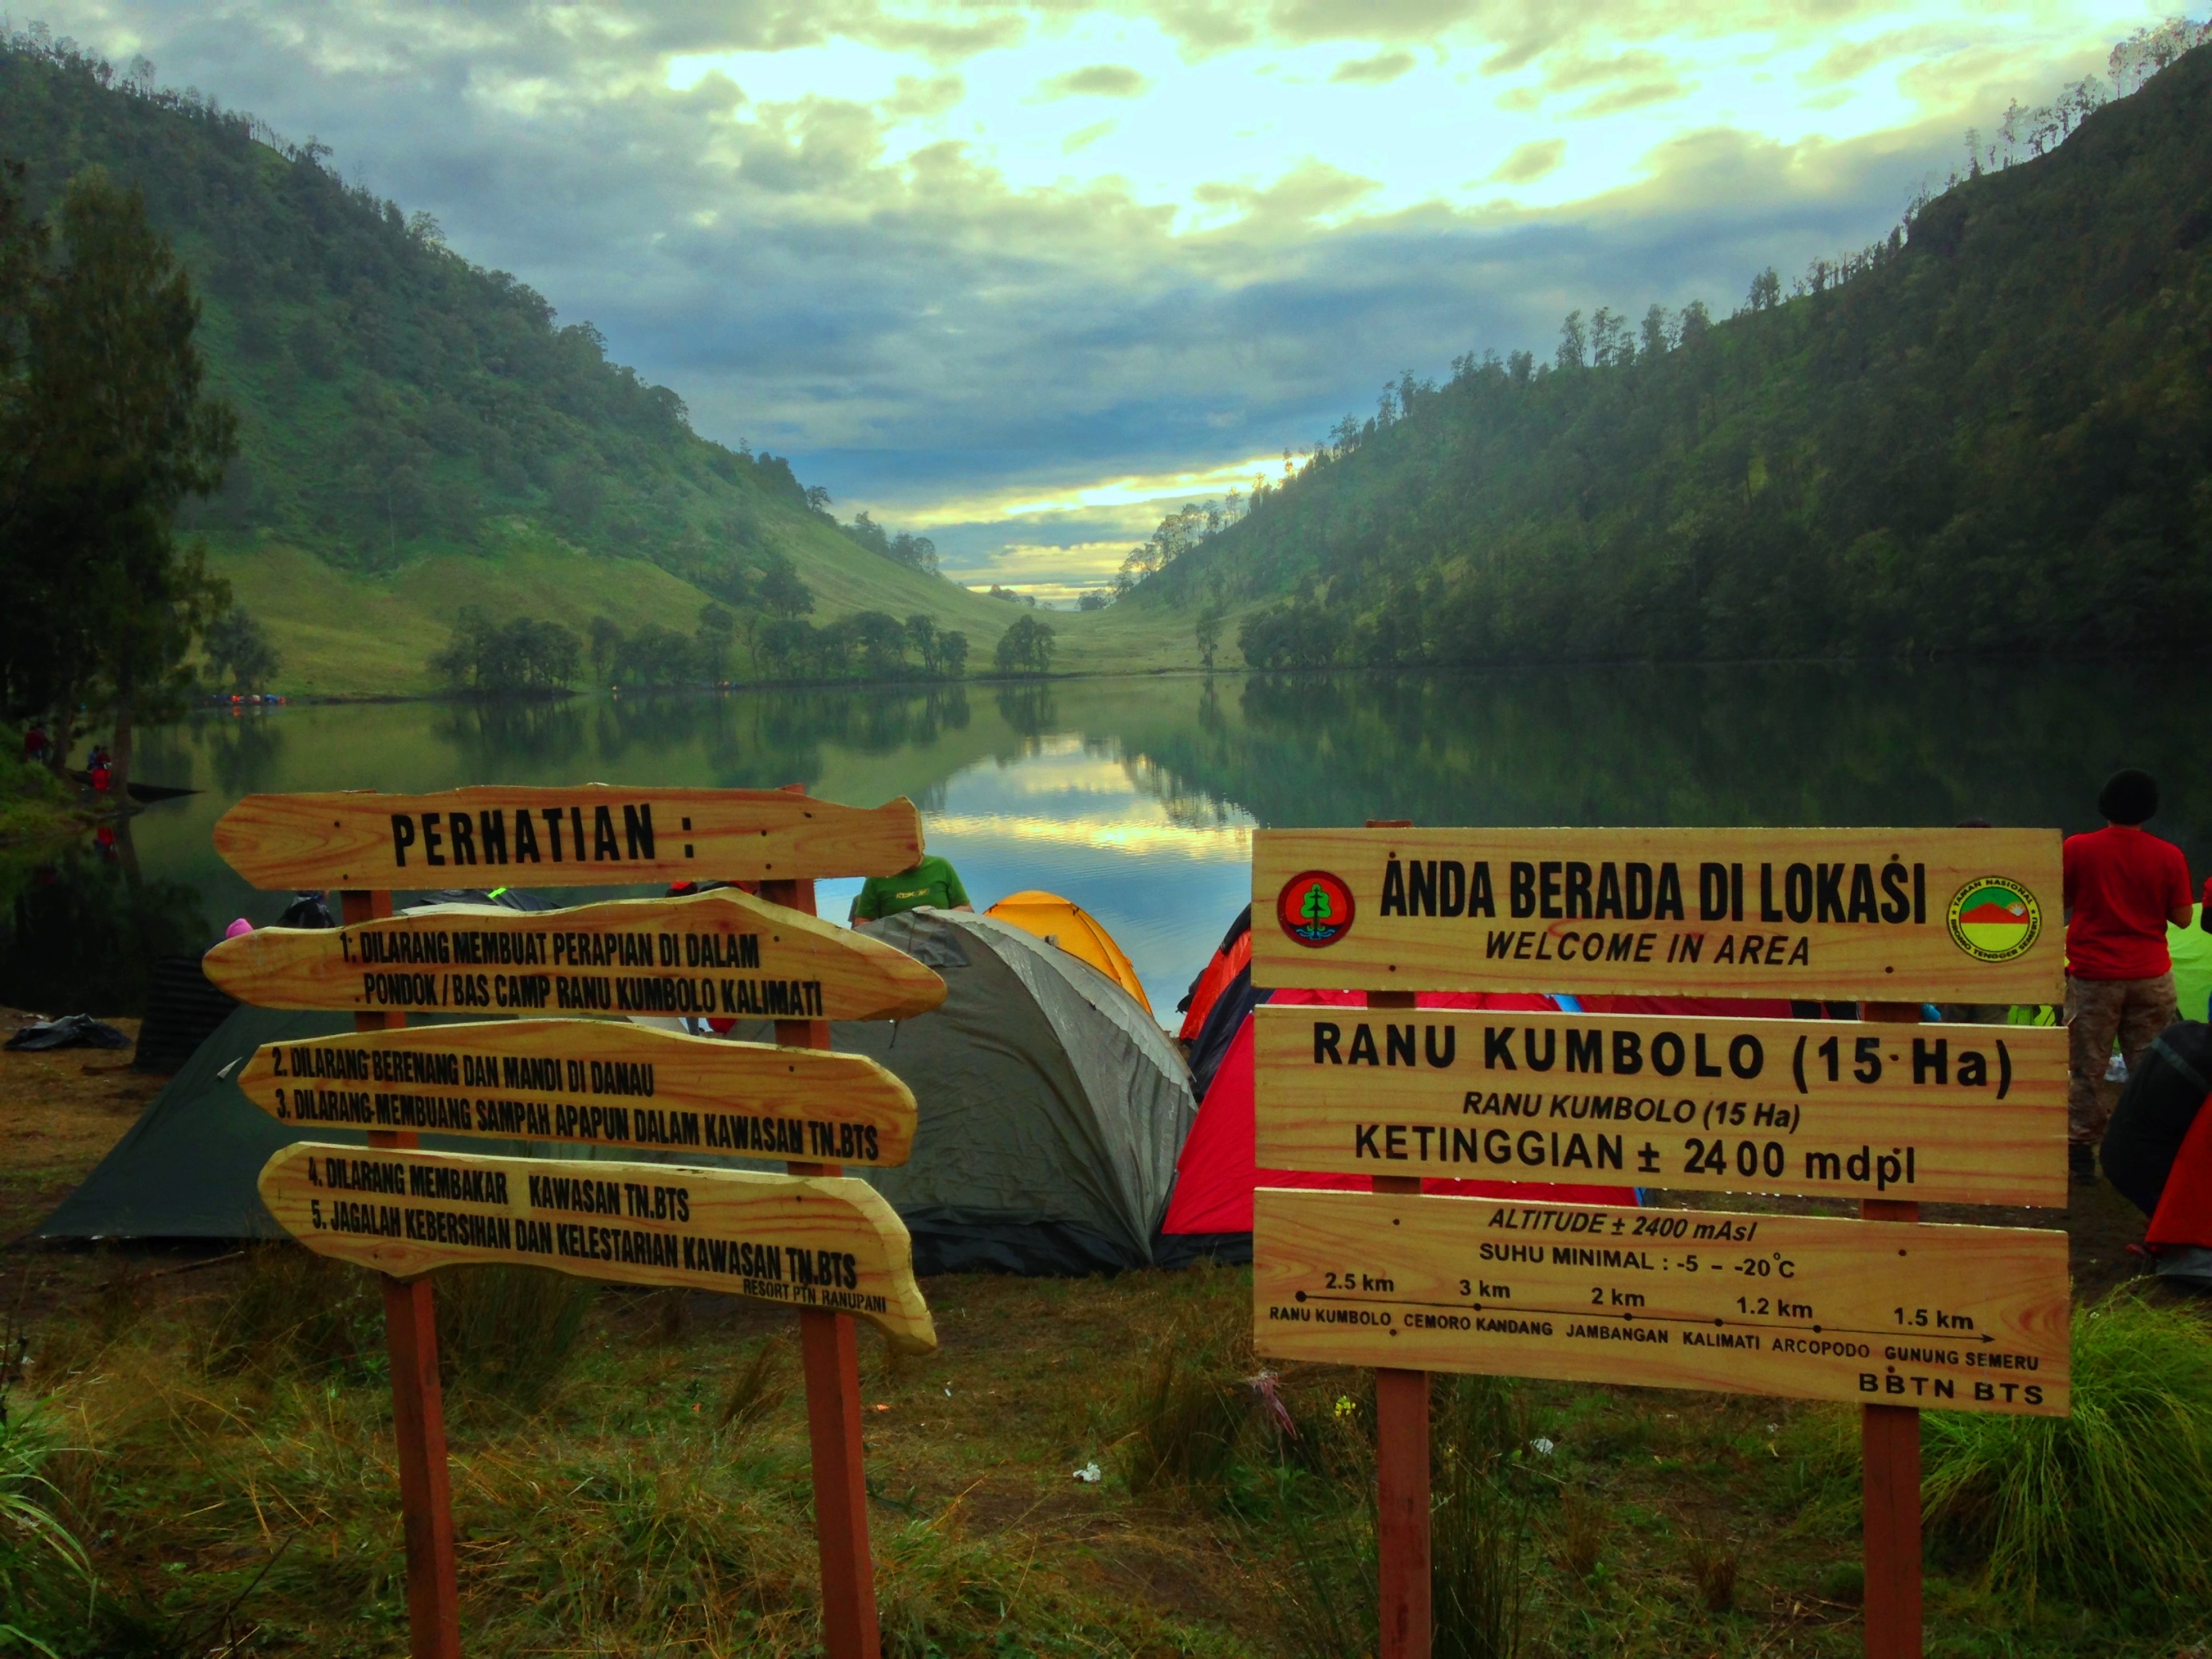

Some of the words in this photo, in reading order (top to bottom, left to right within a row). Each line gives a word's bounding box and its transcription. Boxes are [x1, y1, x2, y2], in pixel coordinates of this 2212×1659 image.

[391, 803, 655, 867] PERHATIAN
[1380, 860, 1496, 918] ANDA
[1510, 861, 1685, 921] BERADA
[1700, 863, 1743, 922] DI
[1761, 863, 1927, 925] LOKASI
[1954, 881, 1982, 906] TAMAN
[1986, 879, 2033, 906] NASIONAL
[360, 931, 450, 964] DILARANG
[451, 931, 547, 965] MEMBUAT
[553, 932, 654, 967] PERAPIAN
[659, 934, 681, 967] DI
[686, 934, 759, 969] DALAM
[1486, 931, 1657, 962] WELCOME
[1667, 934, 1705, 963] IN
[1713, 934, 1809, 966] AREA
[364, 973, 438, 1006] PONDOK
[452, 973, 490, 1008] BAS
[494, 974, 551, 1008] CAMP
[556, 975, 612, 1010] RANU
[616, 977, 716, 1013] KUMBOLO
[721, 979, 823, 1016] KALIMATI
[272, 1047, 288, 1077] 2.
[290, 1048, 368, 1080] DILARANG
[372, 1050, 459, 1086] BERENANG
[462, 1055, 499, 1088] DAN
[502, 1056, 563, 1092] MANDI
[567, 1059, 586, 1094] DI
[590, 1062, 654, 1097] DANAU
[1314, 1022, 1455, 1068] RANU
[1484, 1026, 1764, 1080] KUMBOLO
[1793, 1036, 1882, 1094] (15
[1913, 1038, 2012, 1100] Ha)
[275, 1088, 291, 1118] 3.
[293, 1089, 372, 1124] DILARANG
[374, 1093, 472, 1130] MEMBUANG
[475, 1099, 552, 1135] SAMPAH
[556, 1103, 629, 1141] APAPUN
[633, 1109, 700, 1146] DALAM
[704, 1113, 804, 1154] KAWASAN
[808, 1120, 879, 1161] TN.BTS
[1463, 1091, 1542, 1117] RANU
[1549, 1094, 1696, 1123] KUMBOLO
[1702, 1100, 1747, 1130] (15
[1753, 1103, 1801, 1134] Ha)
[1356, 1124, 1624, 1170] KETINGGIAN
[1637, 1142, 1661, 1174] ±
[1683, 1138, 1785, 1177] 2400
[1805, 1145, 1915, 1192] mdpl
[308, 1156, 323, 1187] 4.
[325, 1157, 405, 1196] DILARANG
[408, 1164, 509, 1205] MEMBAKAR
[528, 1174, 621, 1215] KAWASAN
[624, 1182, 690, 1222] TN.BTS
[1489, 1208, 1608, 1234] ALTITUDE
[1612, 1217, 1625, 1236] ±
[1631, 1216, 1690, 1239] 2400
[311, 1199, 327, 1230] 5.
[404, 1208, 511, 1249] KEBERSIHAN
[515, 1218, 553, 1254] DAN
[556, 1223, 678, 1268] KELESTARIAN
[683, 1236, 782, 1280] KAWASAN
[785, 1247, 858, 1289] TN.BTS
[1479, 1243, 1545, 1263] SUHU
[1552, 1247, 1655, 1271] MINIMAL
[743, 1278, 789, 1300] RESORT
[793, 1286, 817, 1304] PTN
[821, 1289, 888, 1314] RANUPANI
[1324, 1272, 1356, 1291] 2.5
[1363, 1274, 1395, 1292] km
[1459, 1280, 1471, 1296] 3
[1479, 1280, 1511, 1299] km
[1591, 1287, 1604, 1305] 2
[1612, 1288, 1645, 1307] km
[1736, 1296, 1769, 1315] 1.2
[1777, 1299, 1813, 1319] km
[1893, 1307, 1928, 1327] 1.5
[1936, 1310, 1974, 1331] km
[1269, 1307, 1310, 1321] RANU
[1316, 1308, 1391, 1327] KUMBOLO
[1403, 1315, 1471, 1331] CEMORO
[1476, 1318, 1553, 1336] KANDANG
[1566, 1324, 1669, 1343] JAMBANGAN
[1683, 1331, 1760, 1350] KALIMATI
[1772, 1338, 1870, 1358] ARCOPODO
[1884, 1346, 1958, 1366] GUNUNG
[1965, 1352, 2039, 1371] SEMERU
[1859, 1373, 1954, 1399] BBTN
[1974, 1382, 2044, 1405] BTS
